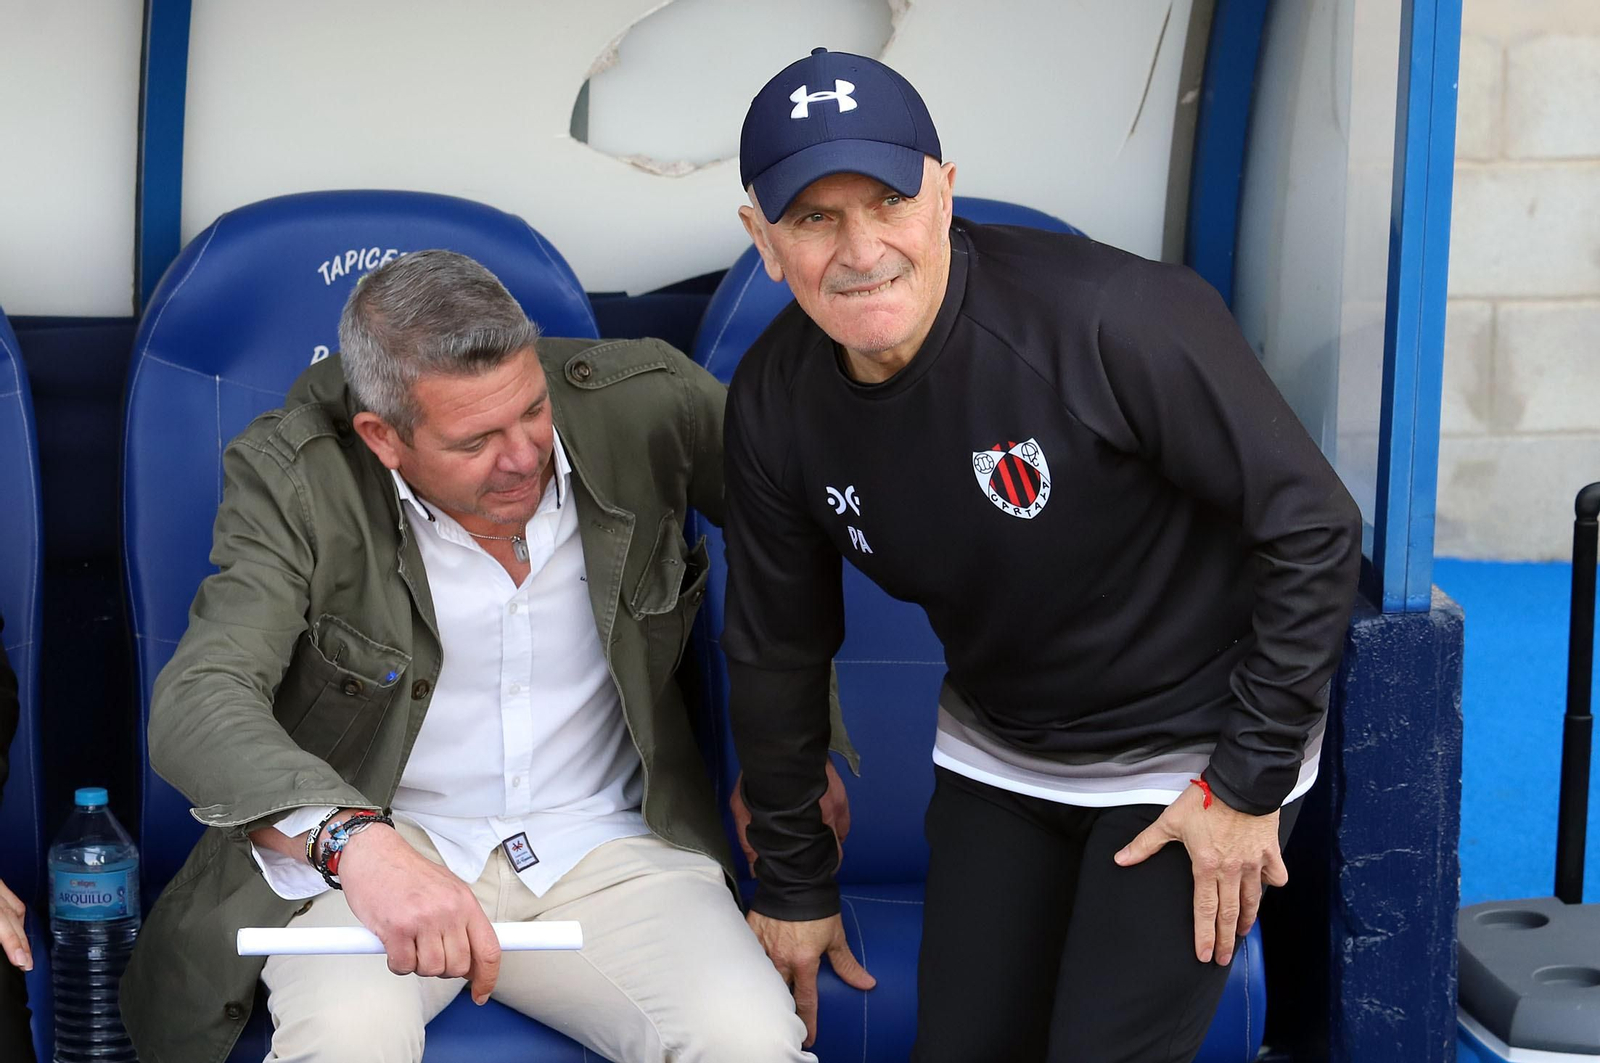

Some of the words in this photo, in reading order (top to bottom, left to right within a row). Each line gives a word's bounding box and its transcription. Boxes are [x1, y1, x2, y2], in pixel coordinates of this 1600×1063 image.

[318, 247, 407, 286] TAPICE
[991, 481, 1049, 517] CARTAYA
[847, 525, 874, 554] PA
[59, 892, 112, 905] ARQUILLO
